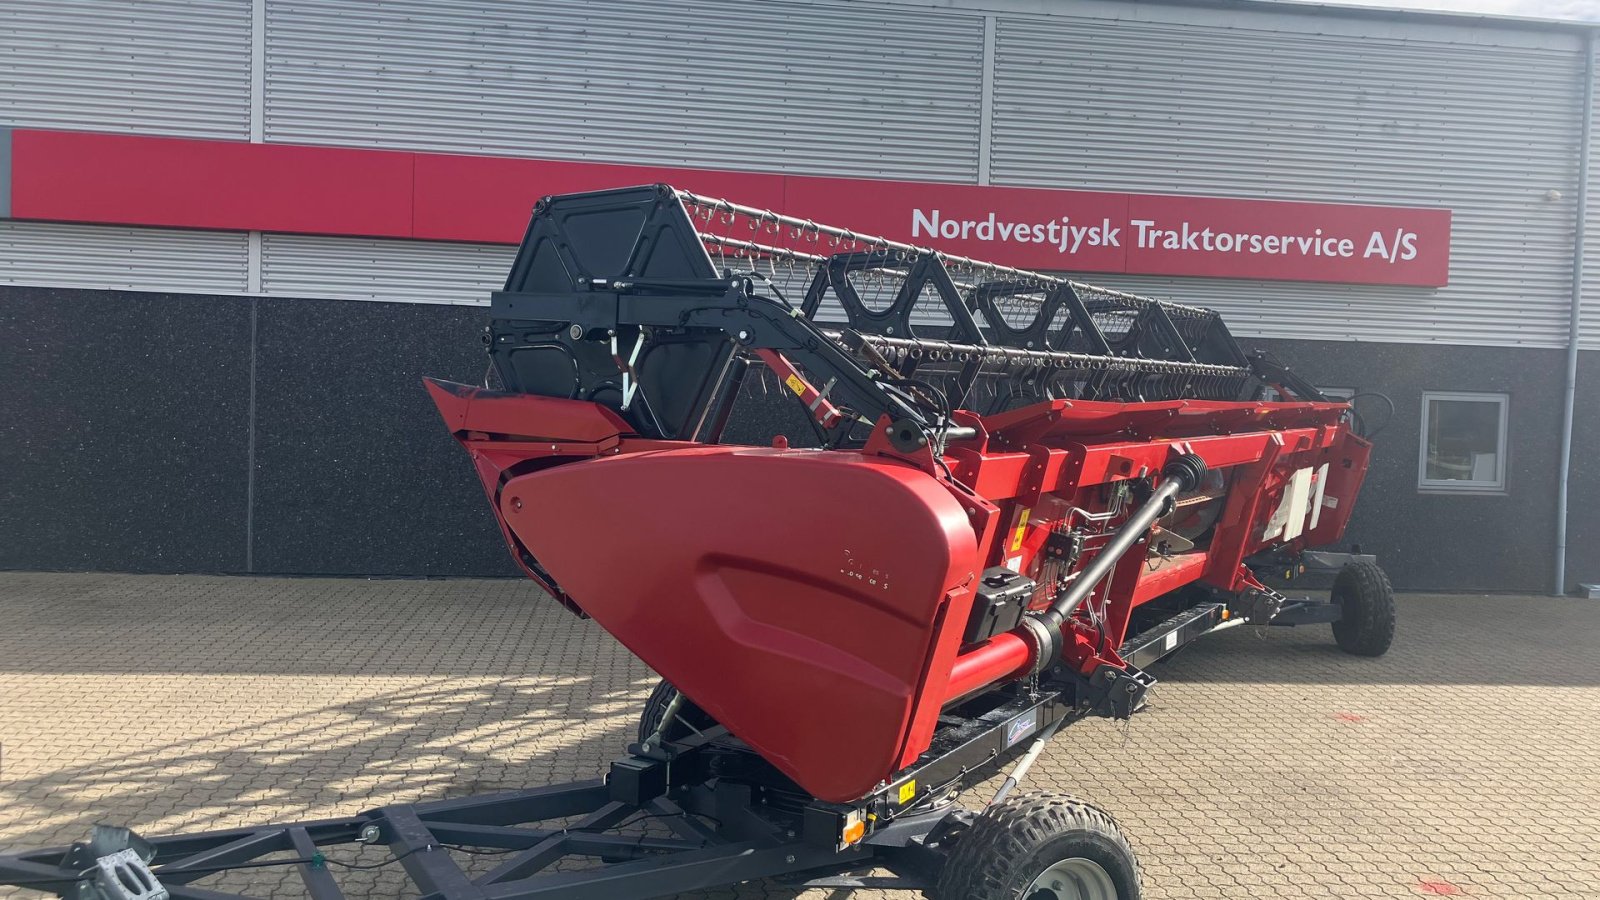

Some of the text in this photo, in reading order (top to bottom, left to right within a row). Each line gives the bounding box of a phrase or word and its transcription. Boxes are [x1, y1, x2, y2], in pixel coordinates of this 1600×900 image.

[912, 208, 1418, 263] Nordvestjysk Traktorservice A/S
